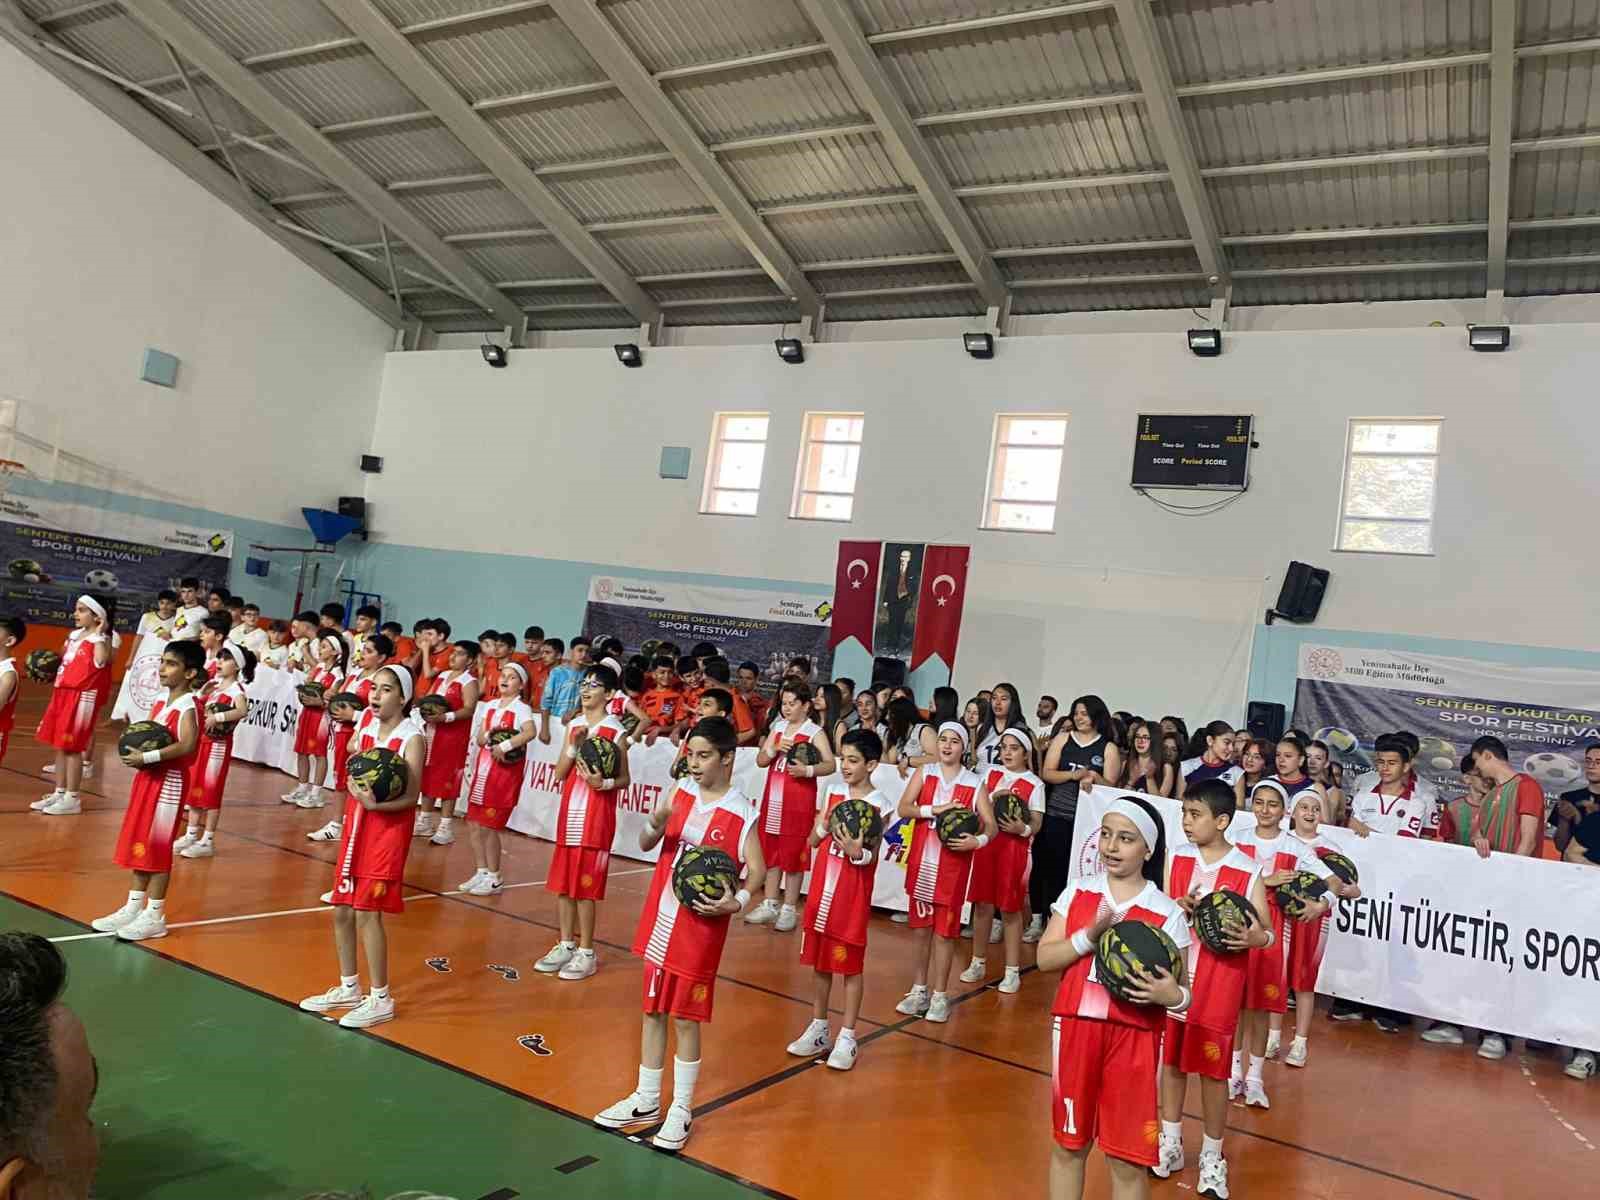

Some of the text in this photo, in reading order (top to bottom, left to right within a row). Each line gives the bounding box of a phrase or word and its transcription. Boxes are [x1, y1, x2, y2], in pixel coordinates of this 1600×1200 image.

[1152, 457, 1175, 465] SCORE
[1180, 457, 1203, 465] Period
[1204, 458, 1228, 466] SCORE
[31, 538, 73, 552] SPOR
[658, 621, 691, 631] SPOR
[1439, 711, 1500, 728] SPOR
[1501, 706, 1593, 724] OKULLAR
[1335, 891, 1600, 982] SENİ TÜKETİR, SPOR
